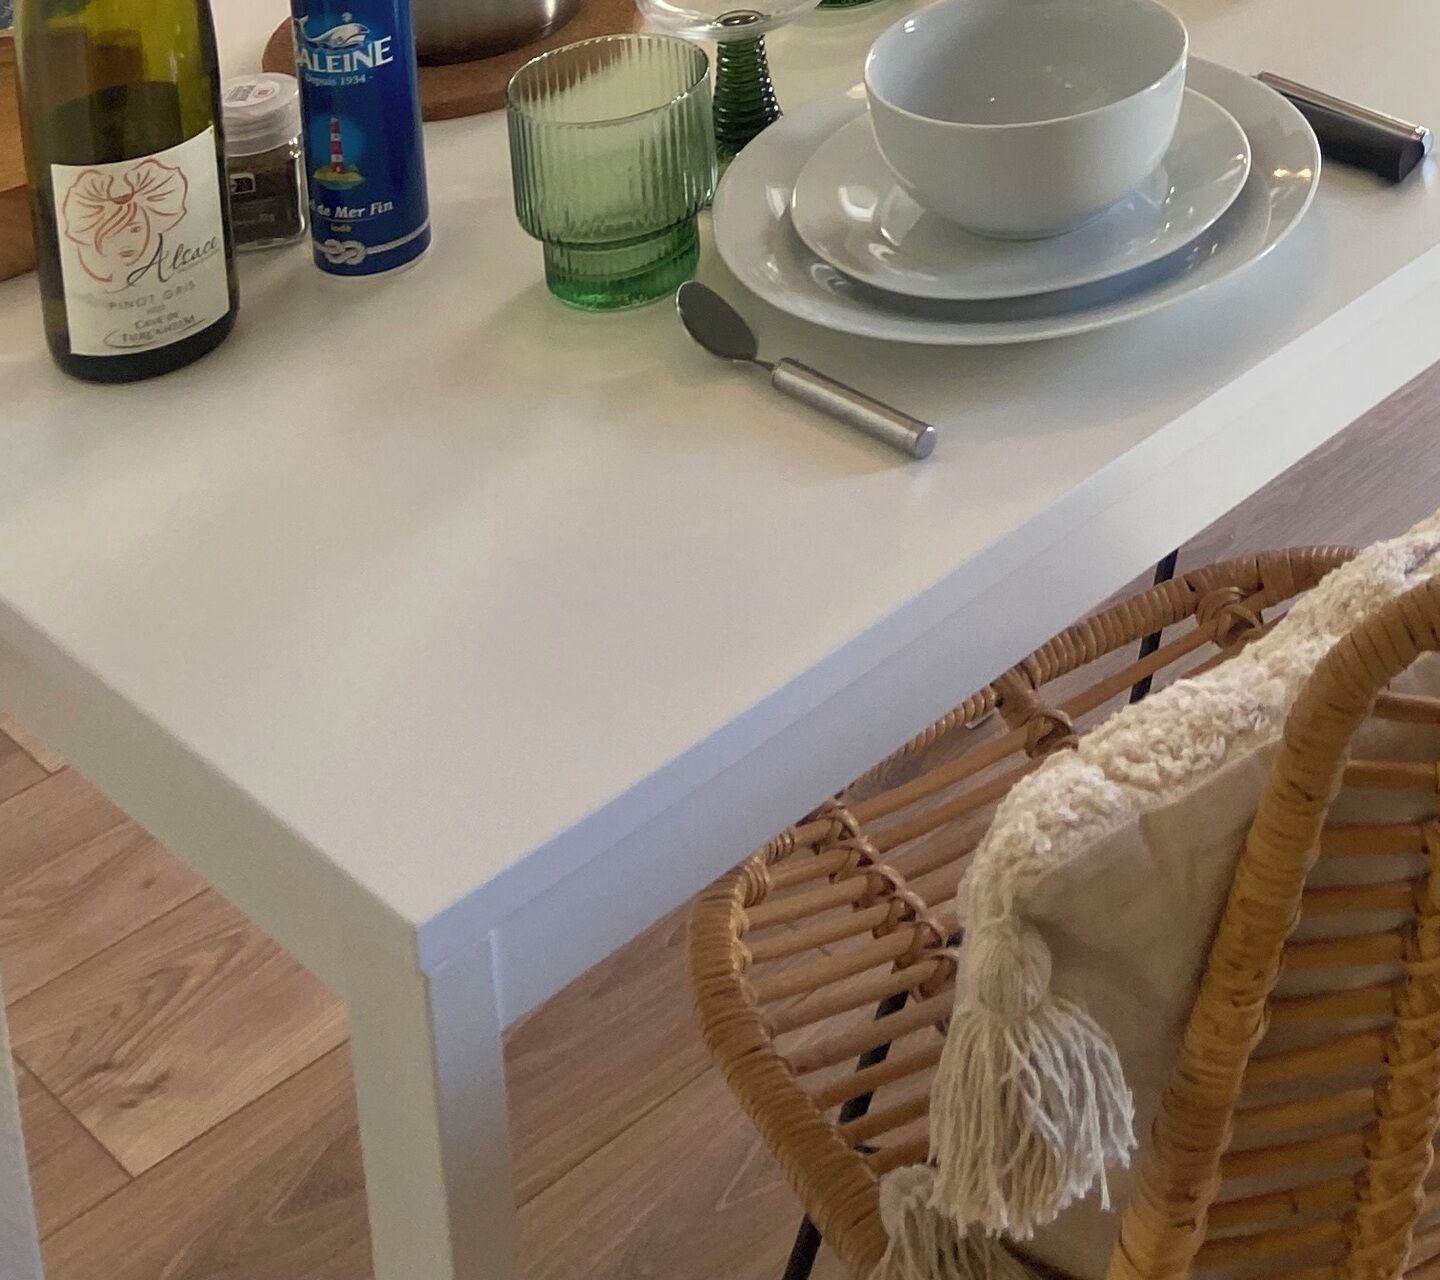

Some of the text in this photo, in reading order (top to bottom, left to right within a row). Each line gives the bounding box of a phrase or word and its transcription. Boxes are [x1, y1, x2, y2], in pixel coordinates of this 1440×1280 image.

[295, 35, 394, 73] ALEINE
[340, 74, 366, 86] 1934
[334, 206, 366, 218] Mer
[369, 201, 394, 216] Fin
[126, 232, 218, 287] Alsace
[108, 294, 155, 311] PINOT
[163, 280, 197, 300] GRIS
